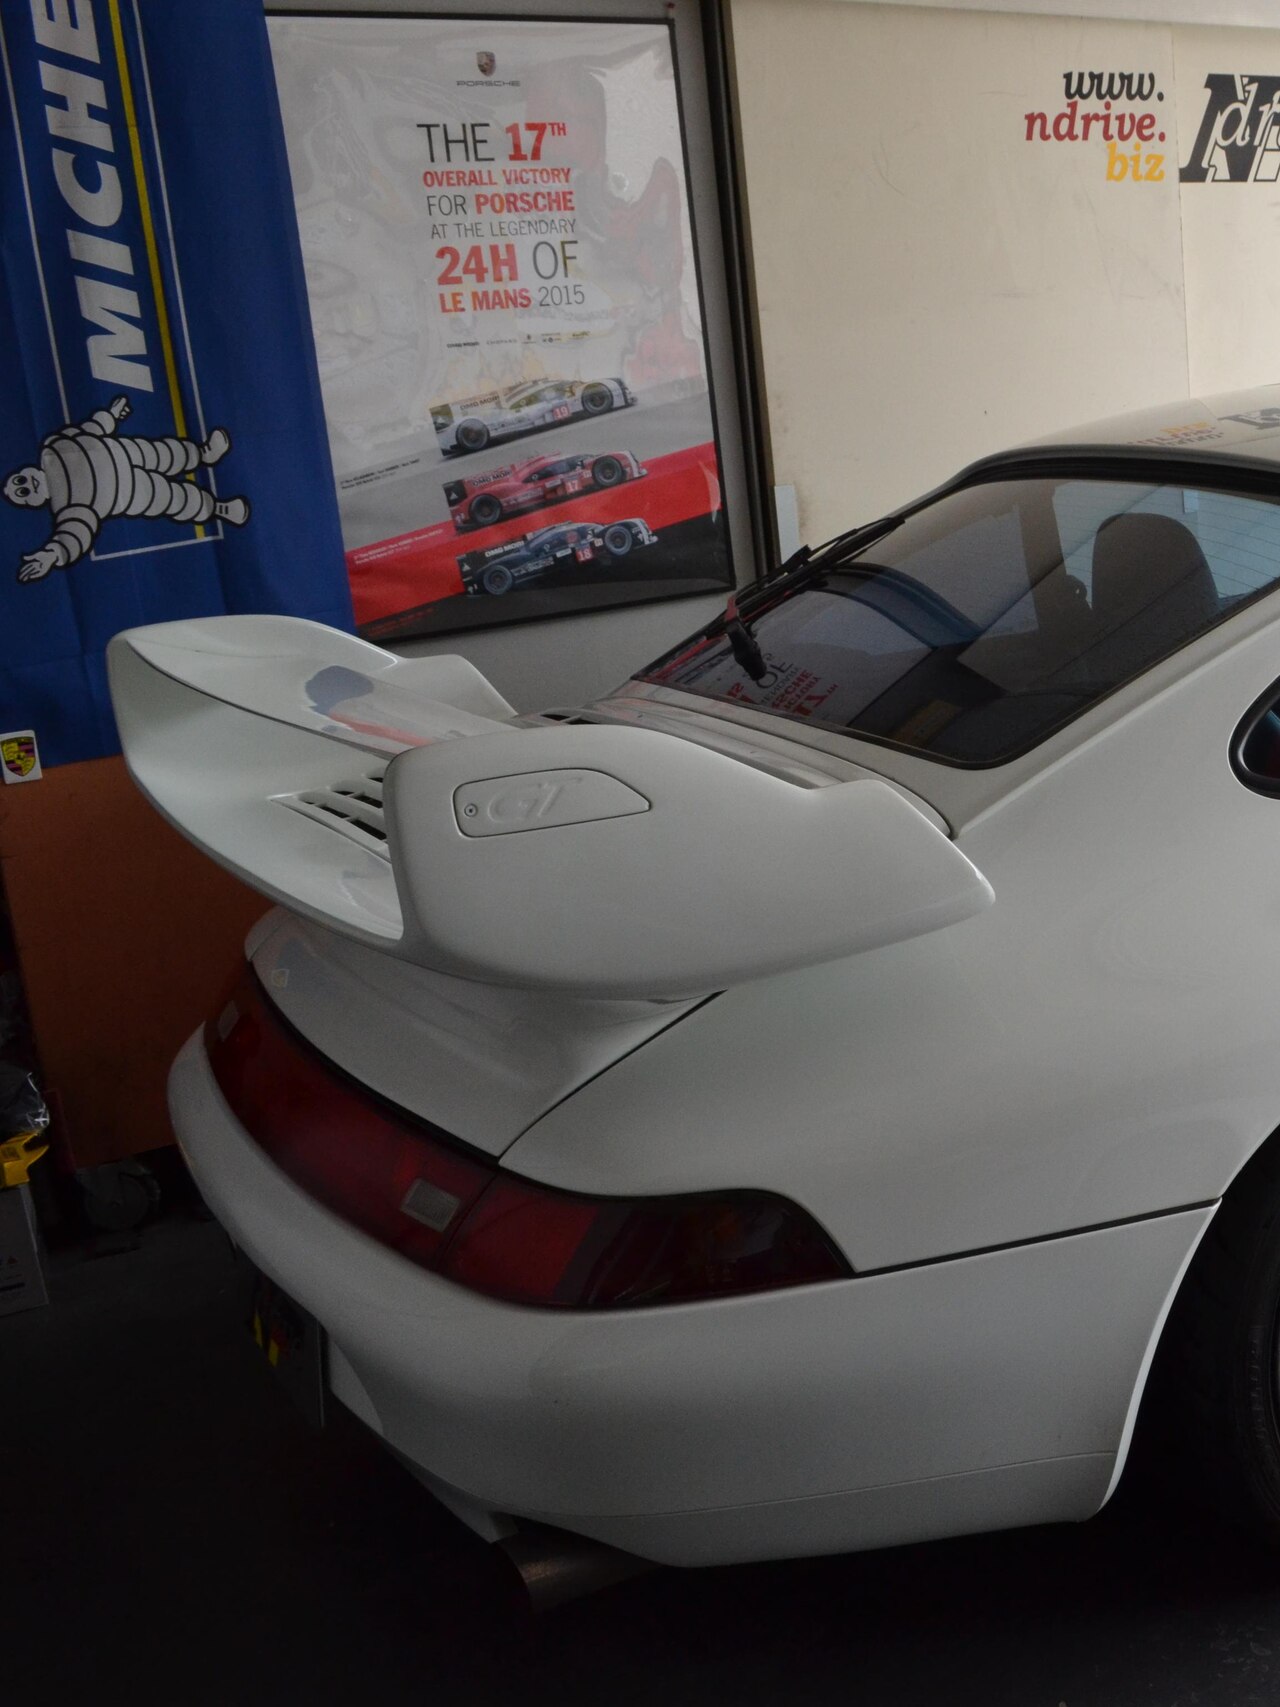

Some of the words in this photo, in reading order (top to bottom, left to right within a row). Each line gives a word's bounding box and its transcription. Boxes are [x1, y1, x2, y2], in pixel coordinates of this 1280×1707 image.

[1063, 71, 1165, 101] www.
[1024, 101, 1166, 142] ndrive.
[416, 123, 495, 163] THE
[505, 122, 567, 162] 17TH
[1106, 142, 1165, 182] biz
[423, 170, 498, 188] OVERALL
[502, 168, 571, 185] VICTORY
[427, 195, 467, 216] FOR
[475, 191, 575, 214] PORSCHE
[431, 223, 448, 239] AT
[453, 222, 485, 238] THE
[490, 218, 577, 237] LEGENDARY
[435, 243, 519, 286] 24H
[532, 240, 578, 280] OF
[439, 292, 466, 313] LE
[471, 288, 532, 311] MANS
[538, 284, 585, 307] 2015
[578, 549, 592, 561] 18
